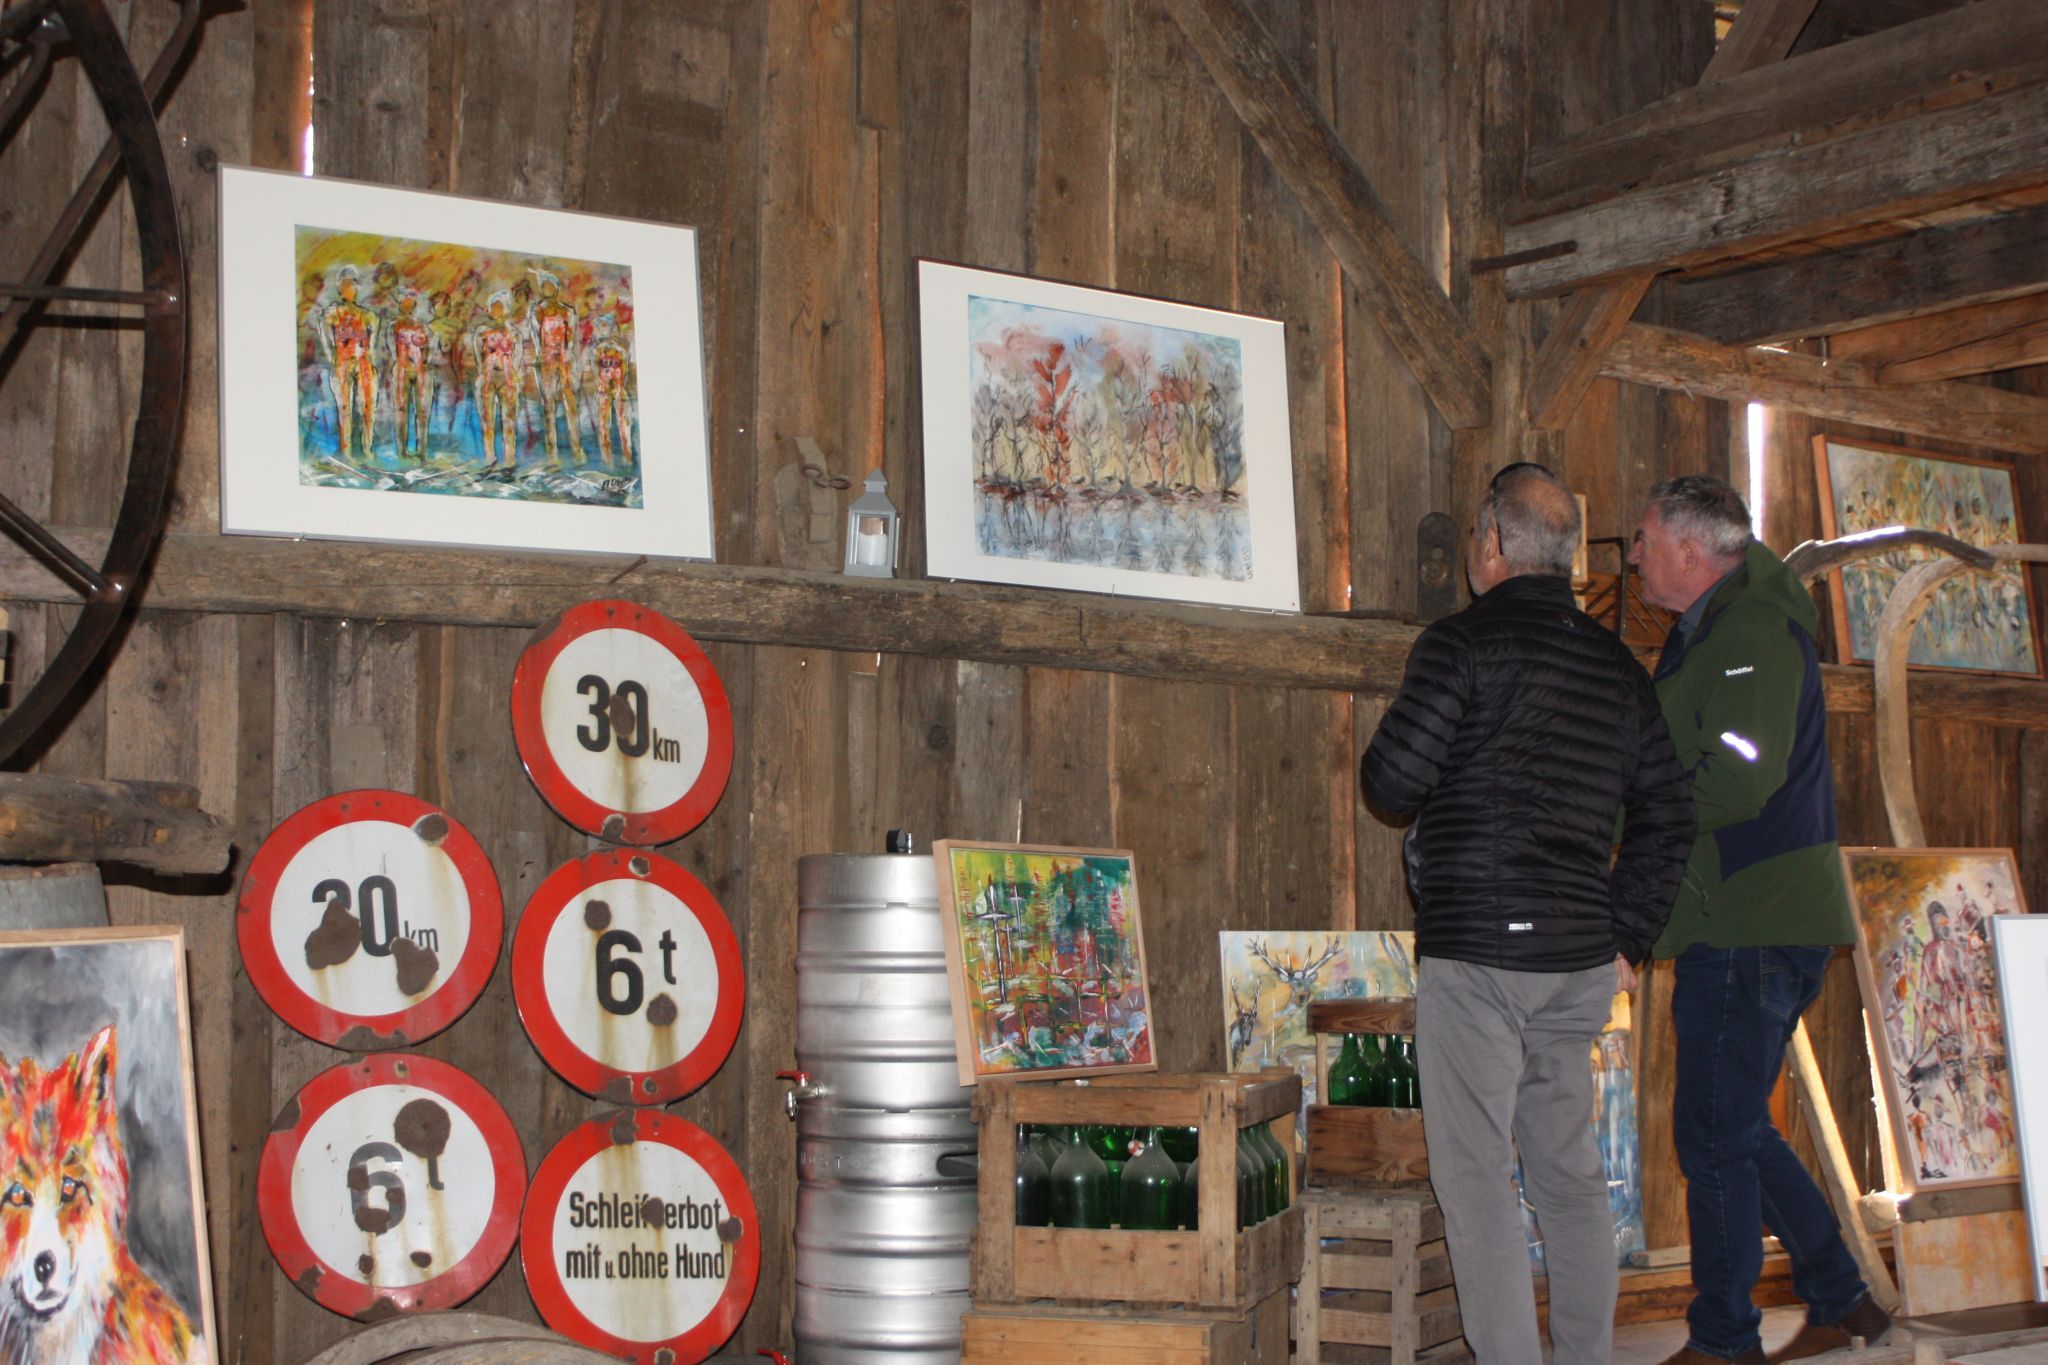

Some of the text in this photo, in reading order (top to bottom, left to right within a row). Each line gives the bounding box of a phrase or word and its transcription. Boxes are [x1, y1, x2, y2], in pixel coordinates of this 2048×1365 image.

[576, 673, 681, 764] 30 km
[596, 928, 677, 1016] 6 t
[347, 1141, 408, 1237] 6
[569, 1190, 722, 1231] Schleiferbot
[566, 1242, 601, 1279] mit
[619, 1242, 669, 1279] ohne
[676, 1242, 726, 1279] Hund
